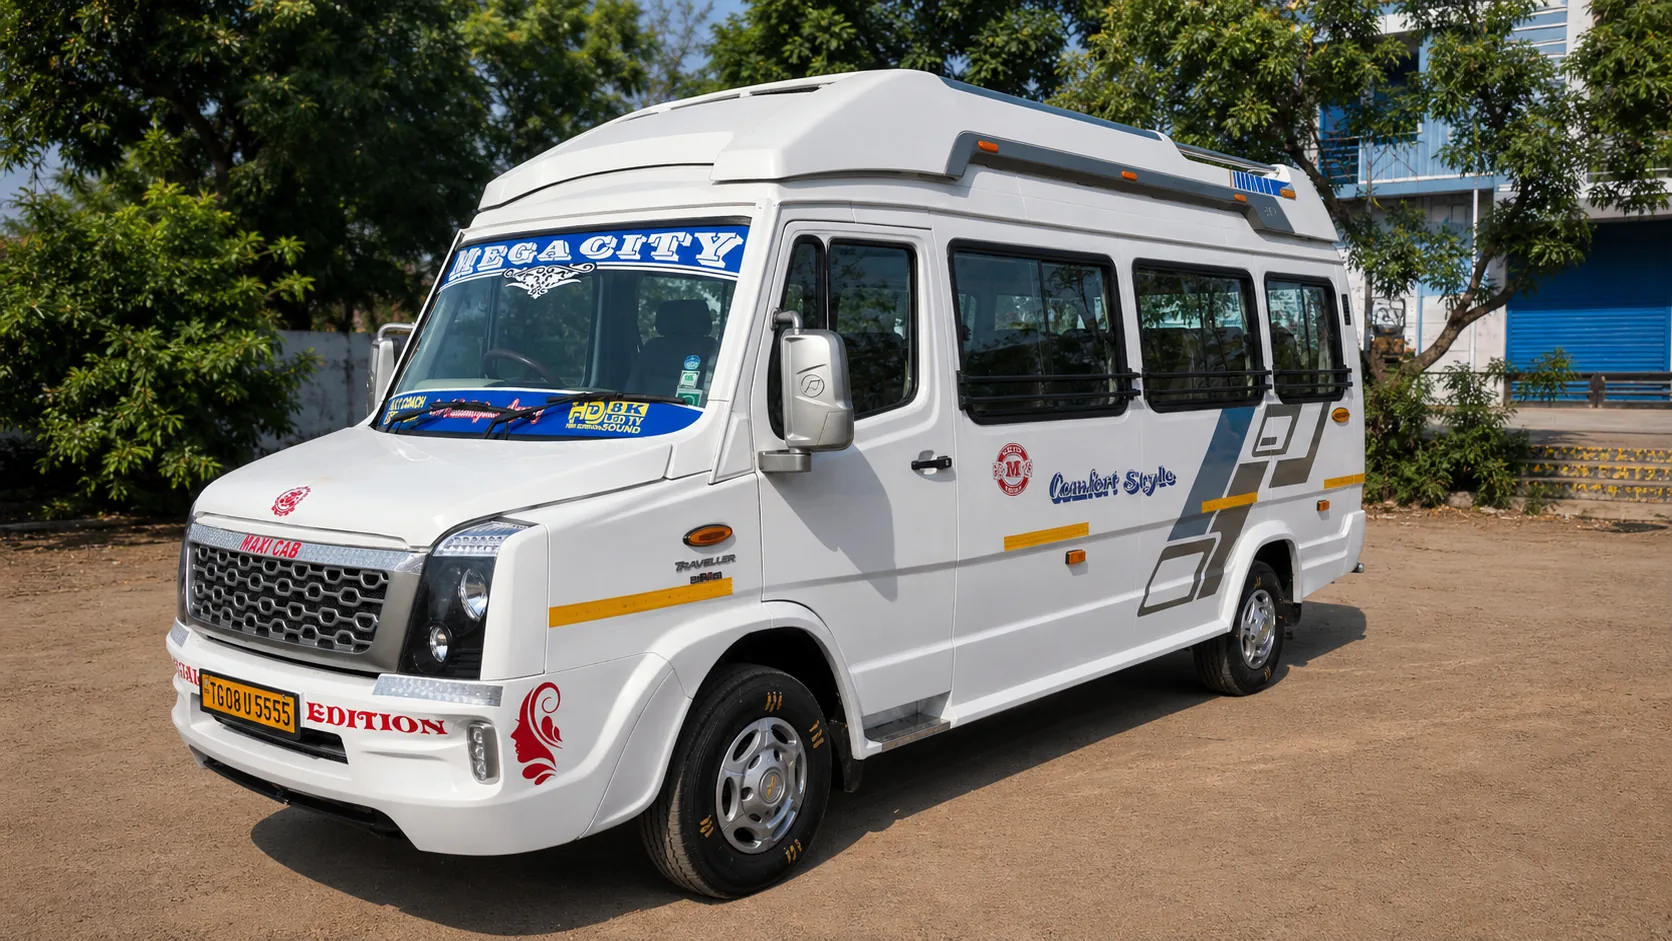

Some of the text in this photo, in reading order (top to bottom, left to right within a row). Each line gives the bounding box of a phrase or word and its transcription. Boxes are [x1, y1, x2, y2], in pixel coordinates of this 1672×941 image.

[448, 231, 744, 281] MEGA CITY
[608, 401, 649, 416] 8K
[601, 423, 641, 434] SOUND
[628, 416, 644, 425] TV
[1005, 460, 1021, 478] M
[1049, 468, 1120, 505] Comfort
[239, 533, 302, 559] MAXI CAB
[674, 553, 737, 573] TRAVELLER
[305, 701, 448, 735] EDITION
